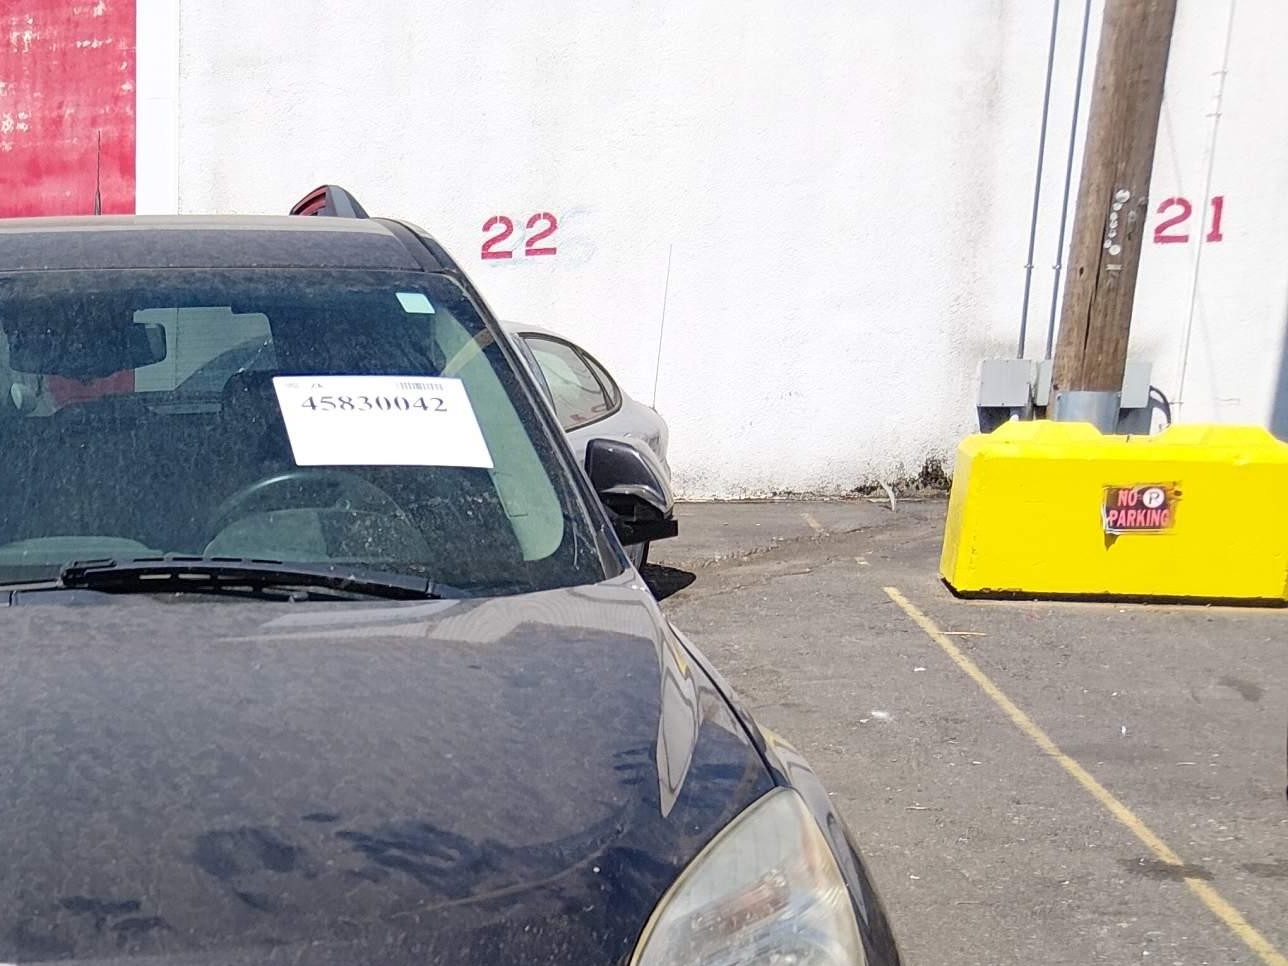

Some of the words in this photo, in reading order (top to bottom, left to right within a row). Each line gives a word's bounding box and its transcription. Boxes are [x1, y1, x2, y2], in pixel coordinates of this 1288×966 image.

[1153, 196, 1224, 243] 21
[480, 212, 558, 259] 22
[301, 395, 448, 413] 45830042
[1118, 489, 1137, 506] NO
[1109, 509, 1170, 527] PARKING
